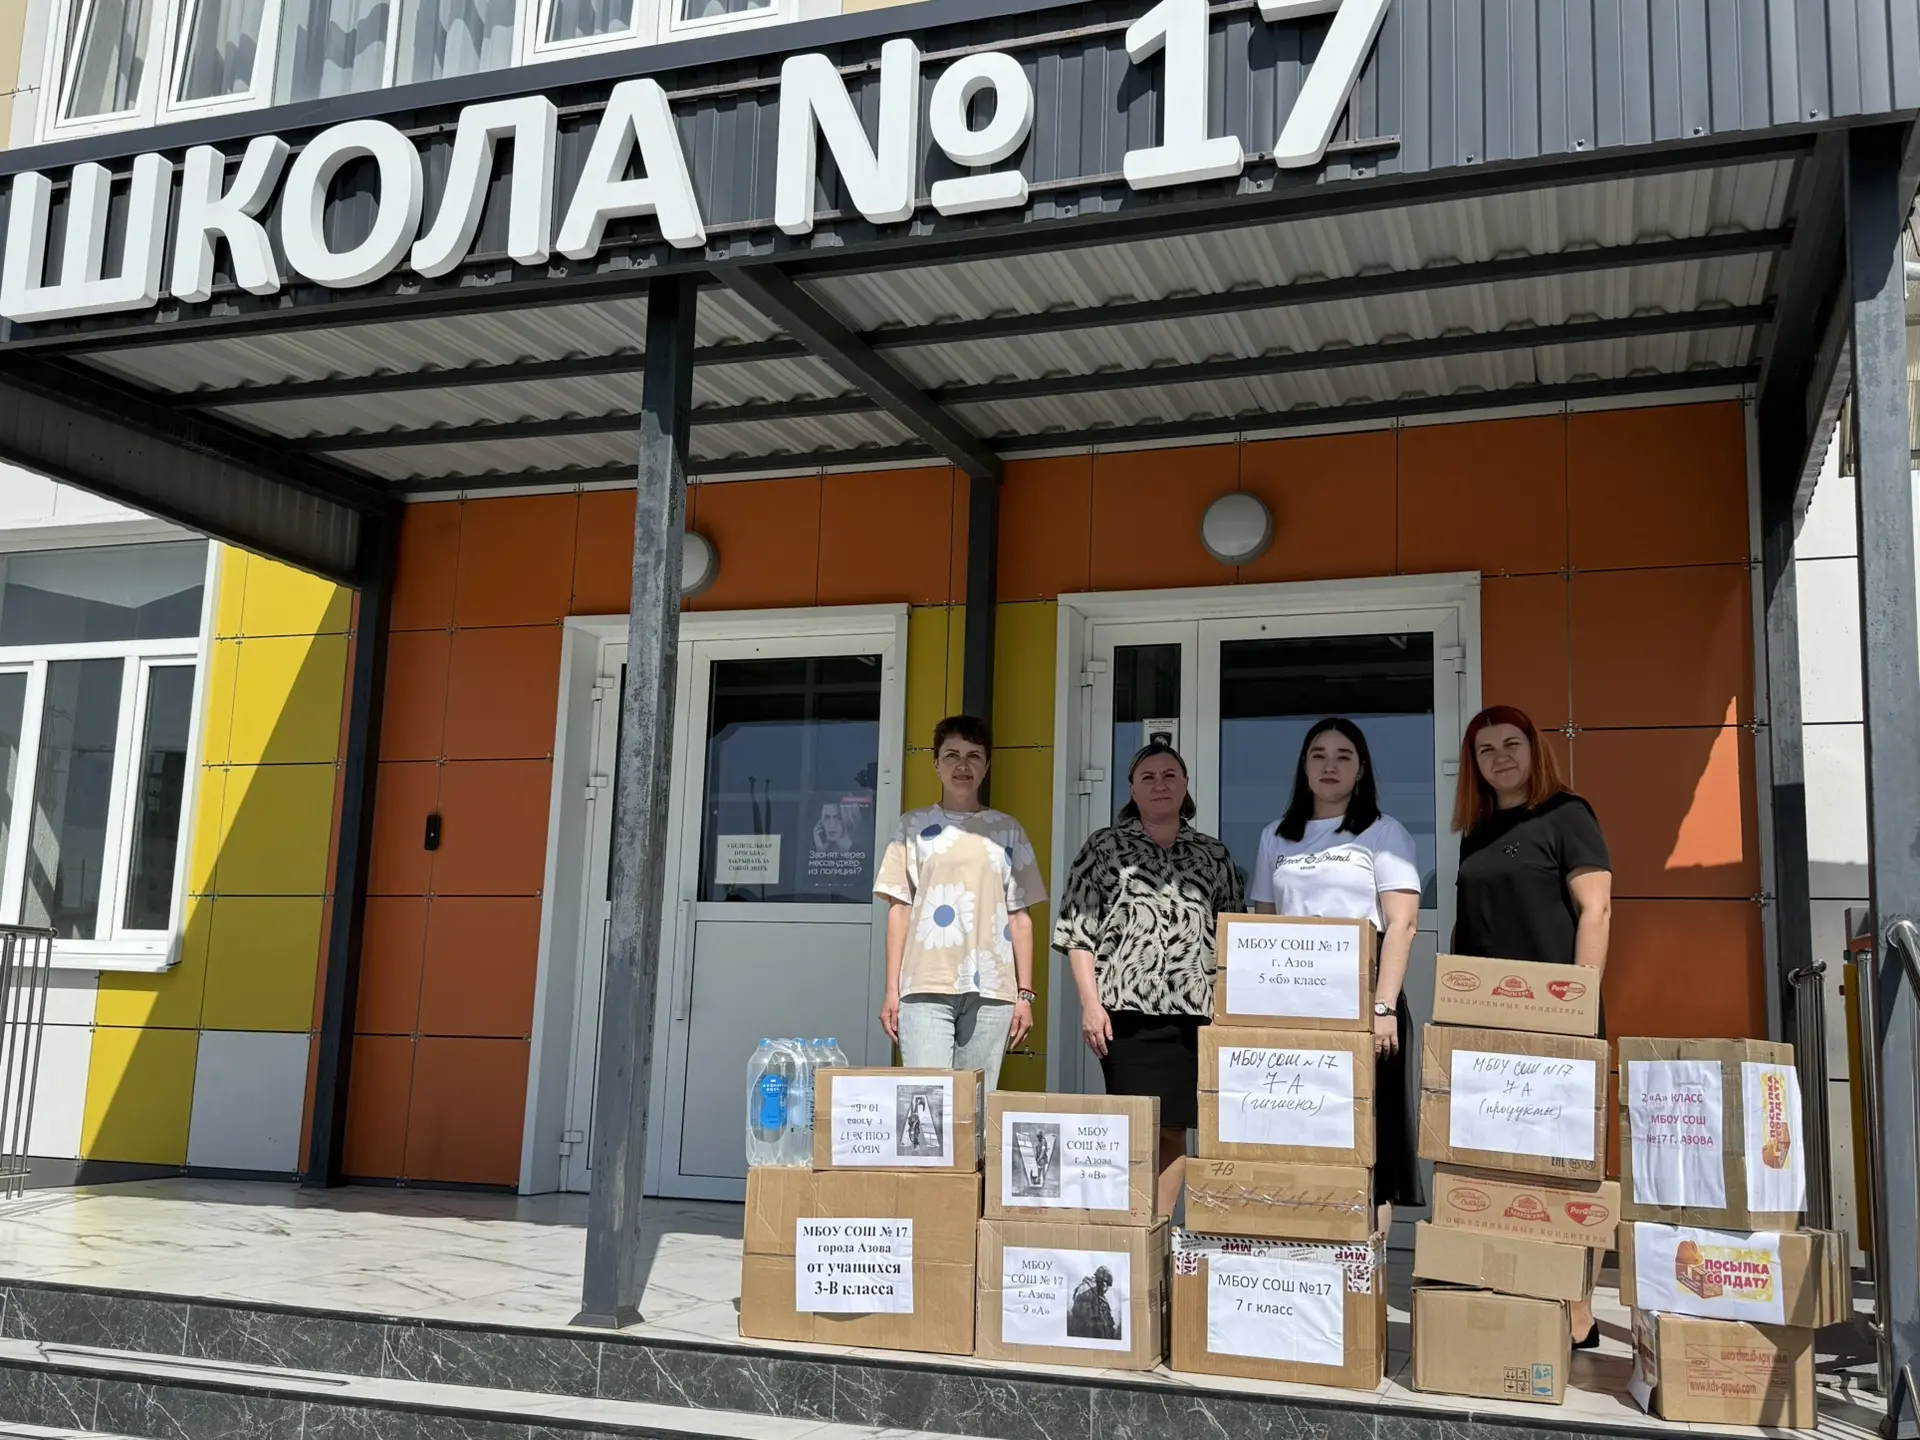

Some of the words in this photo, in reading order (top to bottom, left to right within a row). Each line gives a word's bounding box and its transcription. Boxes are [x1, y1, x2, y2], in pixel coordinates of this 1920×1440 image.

[0, 78, 706, 323] ШКОЛА
[774, 38, 1034, 235] №
[1123, 0, 1393, 190] 17
[840, 851, 866, 860] через
[1237, 938, 1278, 949] МБОУ
[1281, 938, 1314, 950] СОШ
[1318, 940, 1332, 951] №
[1337, 941, 1350, 952] 17
[1271, 959, 1280, 967] г.
[1284, 957, 1314, 968] Азов
[1258, 973, 1265, 984] 5
[1268, 974, 1290, 984] «б»
[1294, 976, 1327, 986] класс
[1229, 1049, 1266, 1068] МБОУ
[1267, 1053, 1300, 1068] СОШ
[1317, 1054, 1339, 1069] 17
[1473, 1057, 1510, 1075] МБОУ
[1514, 1061, 1541, 1076] СОШ
[1641, 1093, 1647, 1102] 2
[1649, 1093, 1668, 1103] «А»
[1671, 1093, 1703, 1103] КЛАСС
[869, 1103, 878, 1112] 10
[1241, 1092, 1325, 1117] (гигиена)
[1478, 1098, 1562, 1122] (продукты)
[1767, 1073, 1776, 1138] ПОСЫЛКА
[1773, 1077, 1783, 1138] СОЛДАТУ
[847, 1118, 873, 1127] Азова
[1651, 1114, 1680, 1124] МБОУ
[1682, 1115, 1706, 1125] СОШ
[840, 1132, 850, 1140] 17
[853, 1131, 863, 1140] №
[865, 1131, 890, 1140] СОШ
[1077, 1126, 1109, 1137] МБОУ
[1066, 1140, 1093, 1151] СОШ
[1095, 1141, 1106, 1151] №
[1109, 1141, 1120, 1152] 17
[1680, 1135, 1714, 1145] АЗОВА
[851, 1145, 881, 1154] МБОУ
[1074, 1156, 1083, 1164] г.
[1085, 1155, 1112, 1165] Азова
[1080, 1170, 1086, 1179] 3
[1088, 1170, 1107, 1180] «В»
[803, 1226, 841, 1237] МБОУ
[844, 1226, 876, 1237] СОШ
[879, 1226, 892, 1237] №
[896, 1227, 908, 1237] 17
[818, 1244, 854, 1255] города
[857, 1242, 891, 1253] Азова
[1221, 1243, 1252, 1253] МИР
[1335, 1251, 1366, 1261] МИР
[807, 1263, 824, 1273] от
[827, 1263, 901, 1277] учащихся
[1022, 1260, 1053, 1270] МБОУ
[1704, 1258, 1770, 1275] ПОСЫЛКА
[1011, 1274, 1037, 1284] СОШ
[1039, 1275, 1051, 1285] №
[1053, 1276, 1064, 1286] 17
[1218, 1274, 1259, 1289] МБОУ
[1262, 1278, 1295, 1293] СОШ
[1299, 1281, 1331, 1296] №17
[1706, 1273, 1770, 1289] СОЛДАТУ
[814, 1281, 838, 1295] 3-В
[842, 1284, 894, 1295] класса
[1028, 1290, 1056, 1300] Азова
[1023, 1304, 1029, 1314] 9
[1031, 1306, 1050, 1316] «А»
[1235, 1298, 1243, 1311] 7
[1247, 1302, 1253, 1312] г
[1256, 1302, 1293, 1316] класс
[1690, 1380, 1757, 1396] www.kdv-group.com
